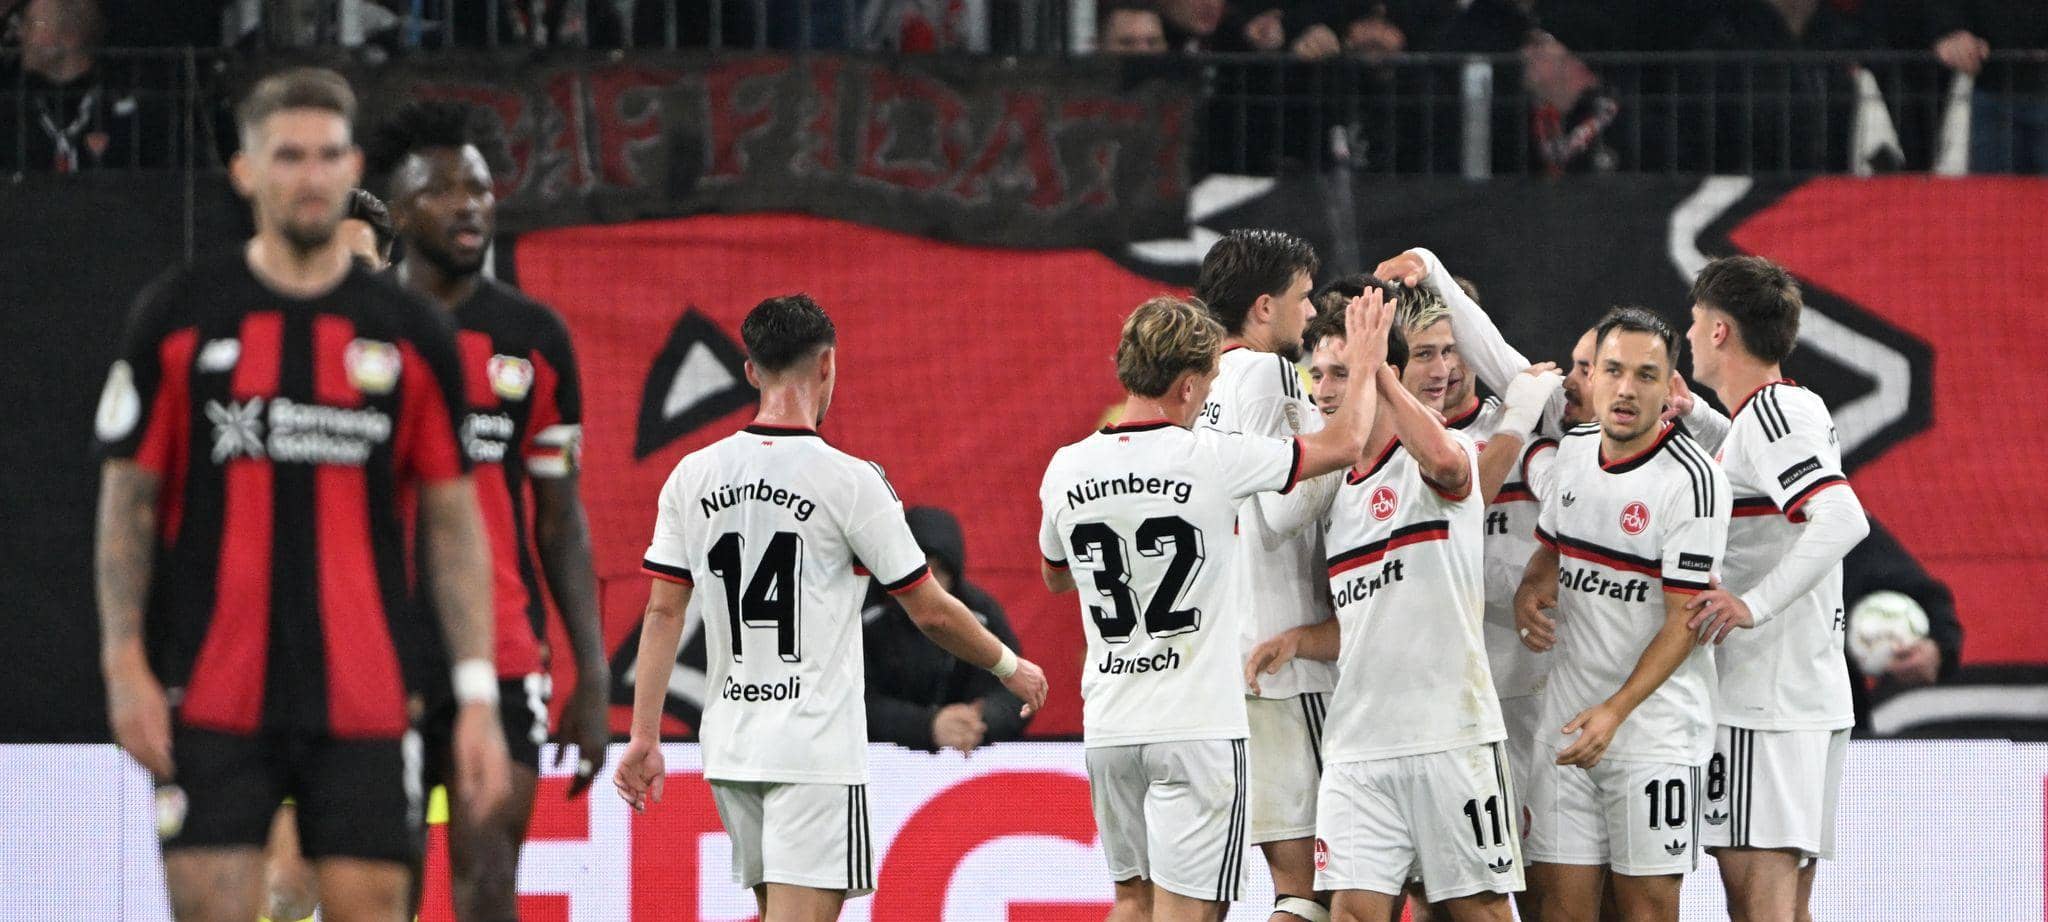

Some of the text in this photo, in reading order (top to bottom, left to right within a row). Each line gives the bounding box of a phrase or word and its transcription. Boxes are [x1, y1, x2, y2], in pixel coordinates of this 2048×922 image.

[700, 478, 816, 522] Nürnberg
[1066, 472, 1193, 510] Nürnberg
[707, 531, 803, 663] 14
[1070, 515, 1206, 644] 32
[1463, 795, 1505, 850] 11
[1645, 779, 1688, 830] 10
